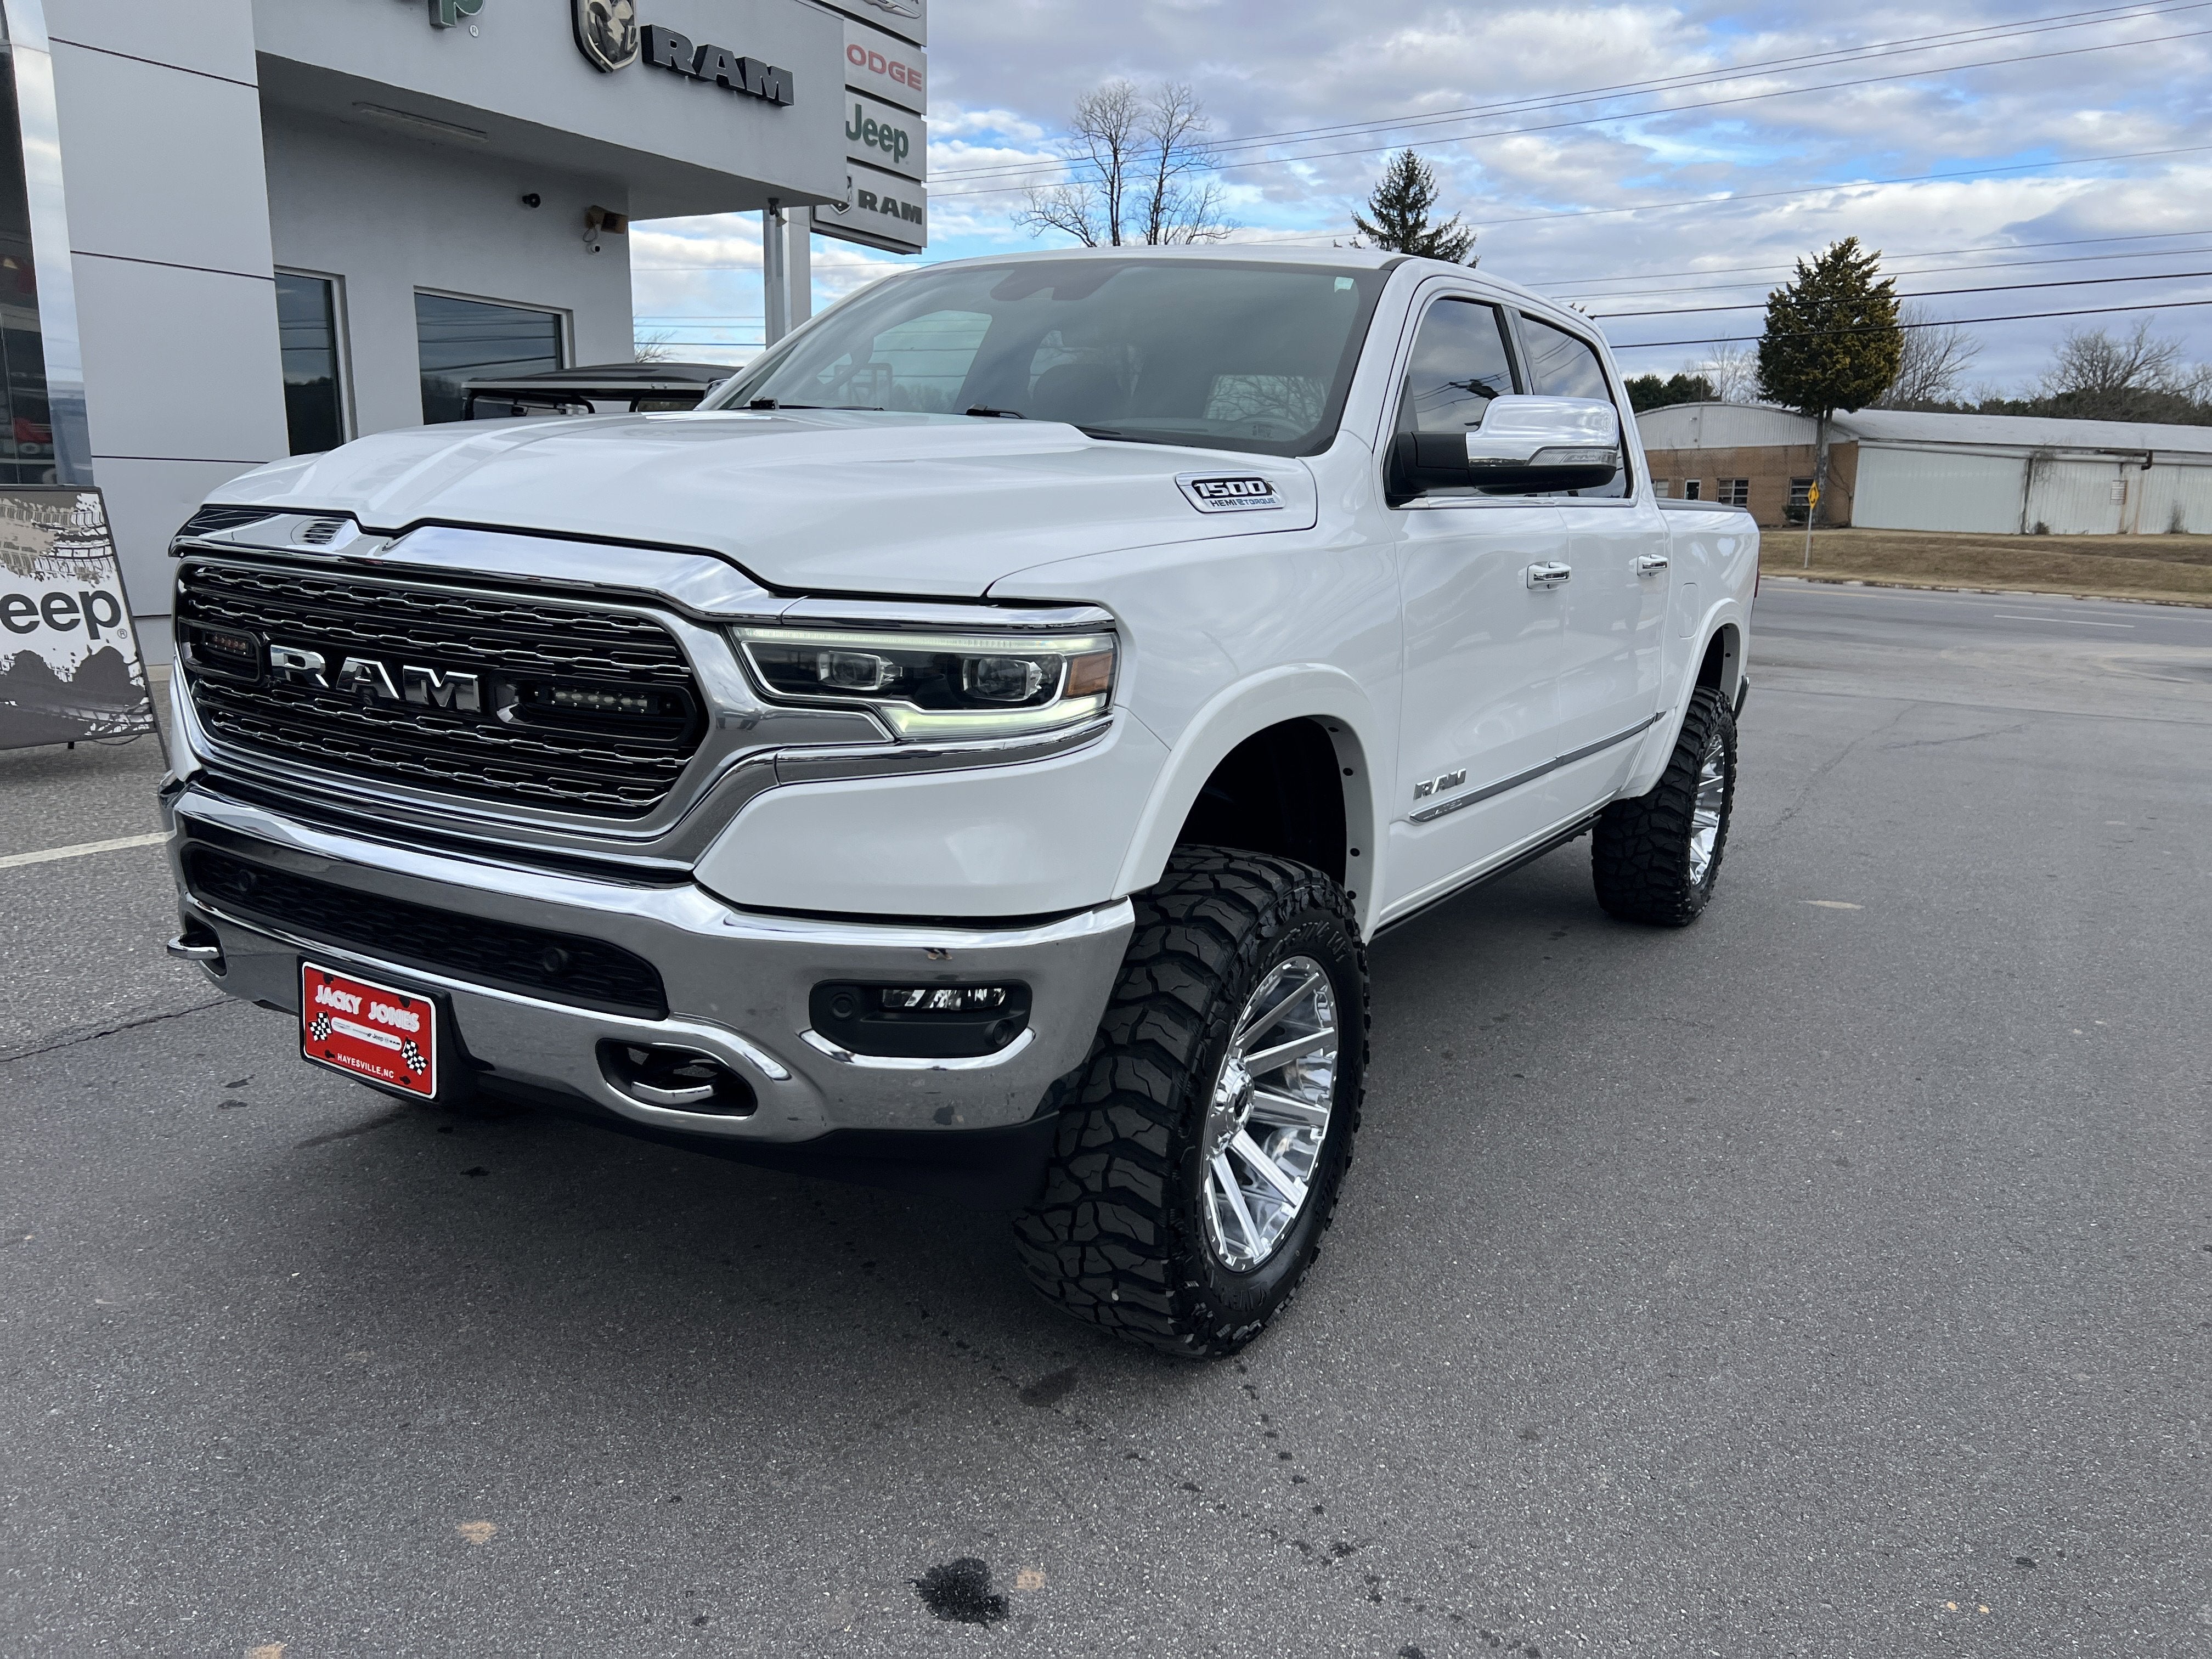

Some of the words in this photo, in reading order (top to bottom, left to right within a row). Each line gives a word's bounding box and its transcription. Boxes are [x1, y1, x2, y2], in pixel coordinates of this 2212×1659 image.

[641, 25, 794, 106] RAM
[847, 44, 922, 92] ODGE
[845, 103, 909, 163] Jeep
[858, 189, 922, 225] RAM
[1194, 481, 1267, 496] 1500
[0, 590, 121, 640] eep
[270, 644, 481, 713] RAM
[1413, 768, 1466, 800] RAM
[315, 985, 362, 1014] JACKY
[368, 1001, 420, 1032] JONES
